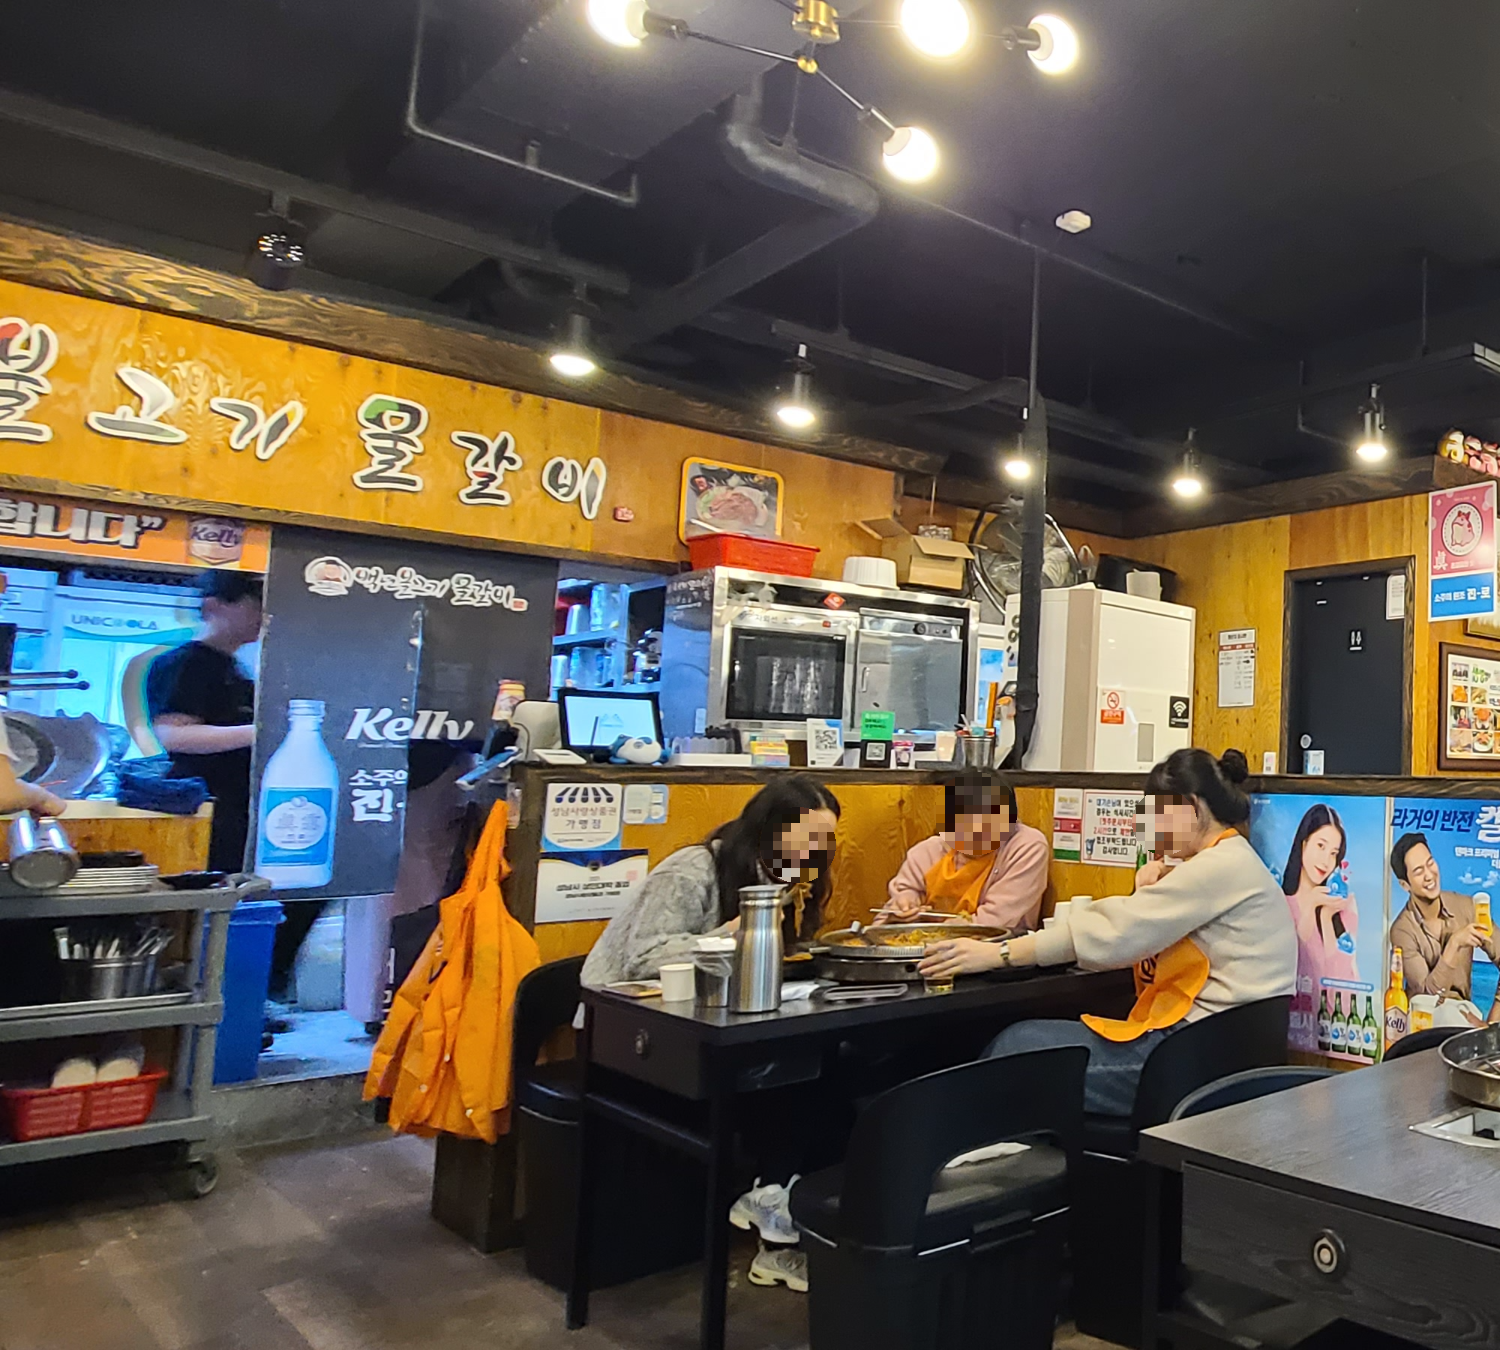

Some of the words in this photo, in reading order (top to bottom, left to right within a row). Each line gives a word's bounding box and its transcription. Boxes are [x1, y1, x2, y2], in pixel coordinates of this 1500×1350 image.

[352, 393, 607, 520] 물갈비
[450, 573, 515, 608] 물갈비
[551, 807, 617, 817] 성남사랑상품권
[1390, 808, 1440, 830] 라거의
[1440, 809, 1475, 832] 반전
[1386, 1016, 1406, 1033] Kelly
